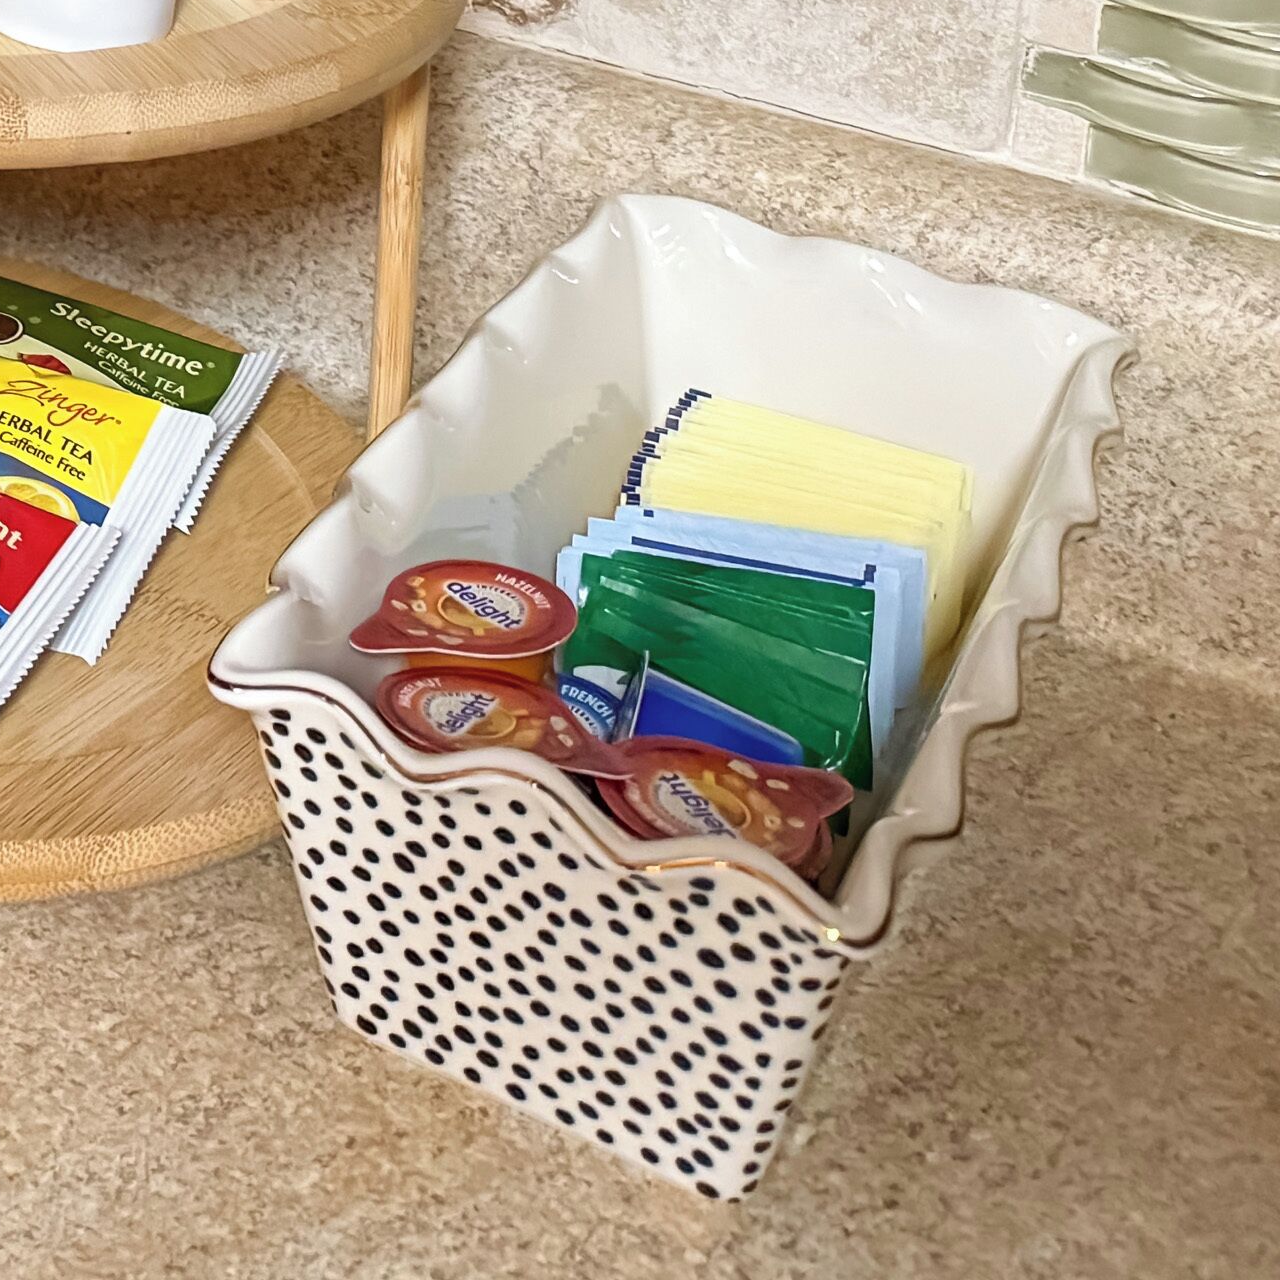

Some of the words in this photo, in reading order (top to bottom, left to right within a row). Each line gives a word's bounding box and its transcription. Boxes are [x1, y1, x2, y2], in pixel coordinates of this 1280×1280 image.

[49, 302, 203, 376] Sleepytime
[83, 341, 149, 384] HERBAL
[154, 376, 186, 400] TEA
[98, 361, 150, 394] Caffeine
[0, 430, 56, 465] Caffeine
[56, 457, 87, 482] Free
[61, 436, 94, 466] TEA
[446, 582, 522, 628] delight
[495, 572, 551, 609] HAZELNUT
[561, 684, 614, 718] FRENCH
